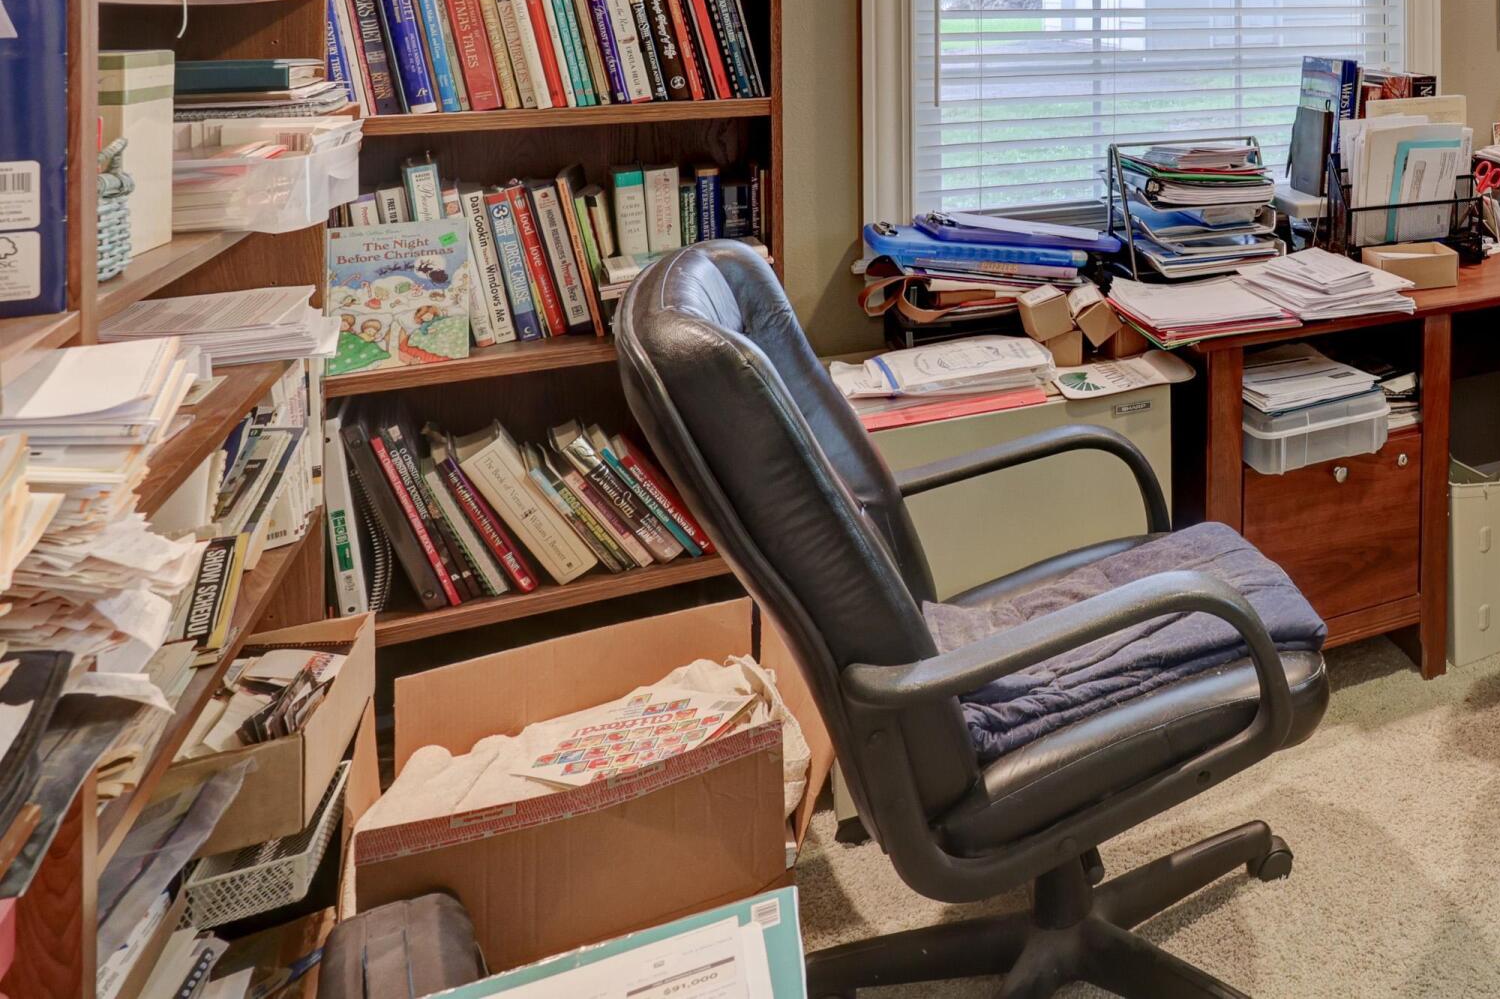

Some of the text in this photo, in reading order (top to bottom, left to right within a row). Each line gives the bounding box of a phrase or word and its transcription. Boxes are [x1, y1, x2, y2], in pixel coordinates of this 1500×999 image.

[360, 19, 381, 43] DIET
[462, 35, 479, 68] TALES
[501, 5, 529, 83] SMALL MIRACLES
[625, 46, 641, 86] URSULA HEGI
[372, 72, 387, 99] RUBIN
[386, 198, 396, 211] FREE
[470, 196, 482, 215] Dan
[701, 180, 709, 210] REVERSE
[492, 206, 508, 220] 3
[474, 215, 490, 248] Gookin
[545, 209, 565, 259] HOME REMEDIES
[336, 247, 454, 265] Before Christmas
[363, 237, 430, 252] The Night
[530, 245, 543, 267] love
[503, 241, 531, 305] JORGE CRUISE
[981, 261, 1019, 273] PUZZLES
[485, 264, 503, 307] Windows
[494, 309, 505, 323] Me
[483, 456, 495, 470] The
[492, 470, 506, 483] Book
[631, 484, 652, 504] PSALM
[199, 549, 227, 584] SHOW
[571, 713, 674, 738] Clifford!
[663, 972, 718, 996] $91,000
